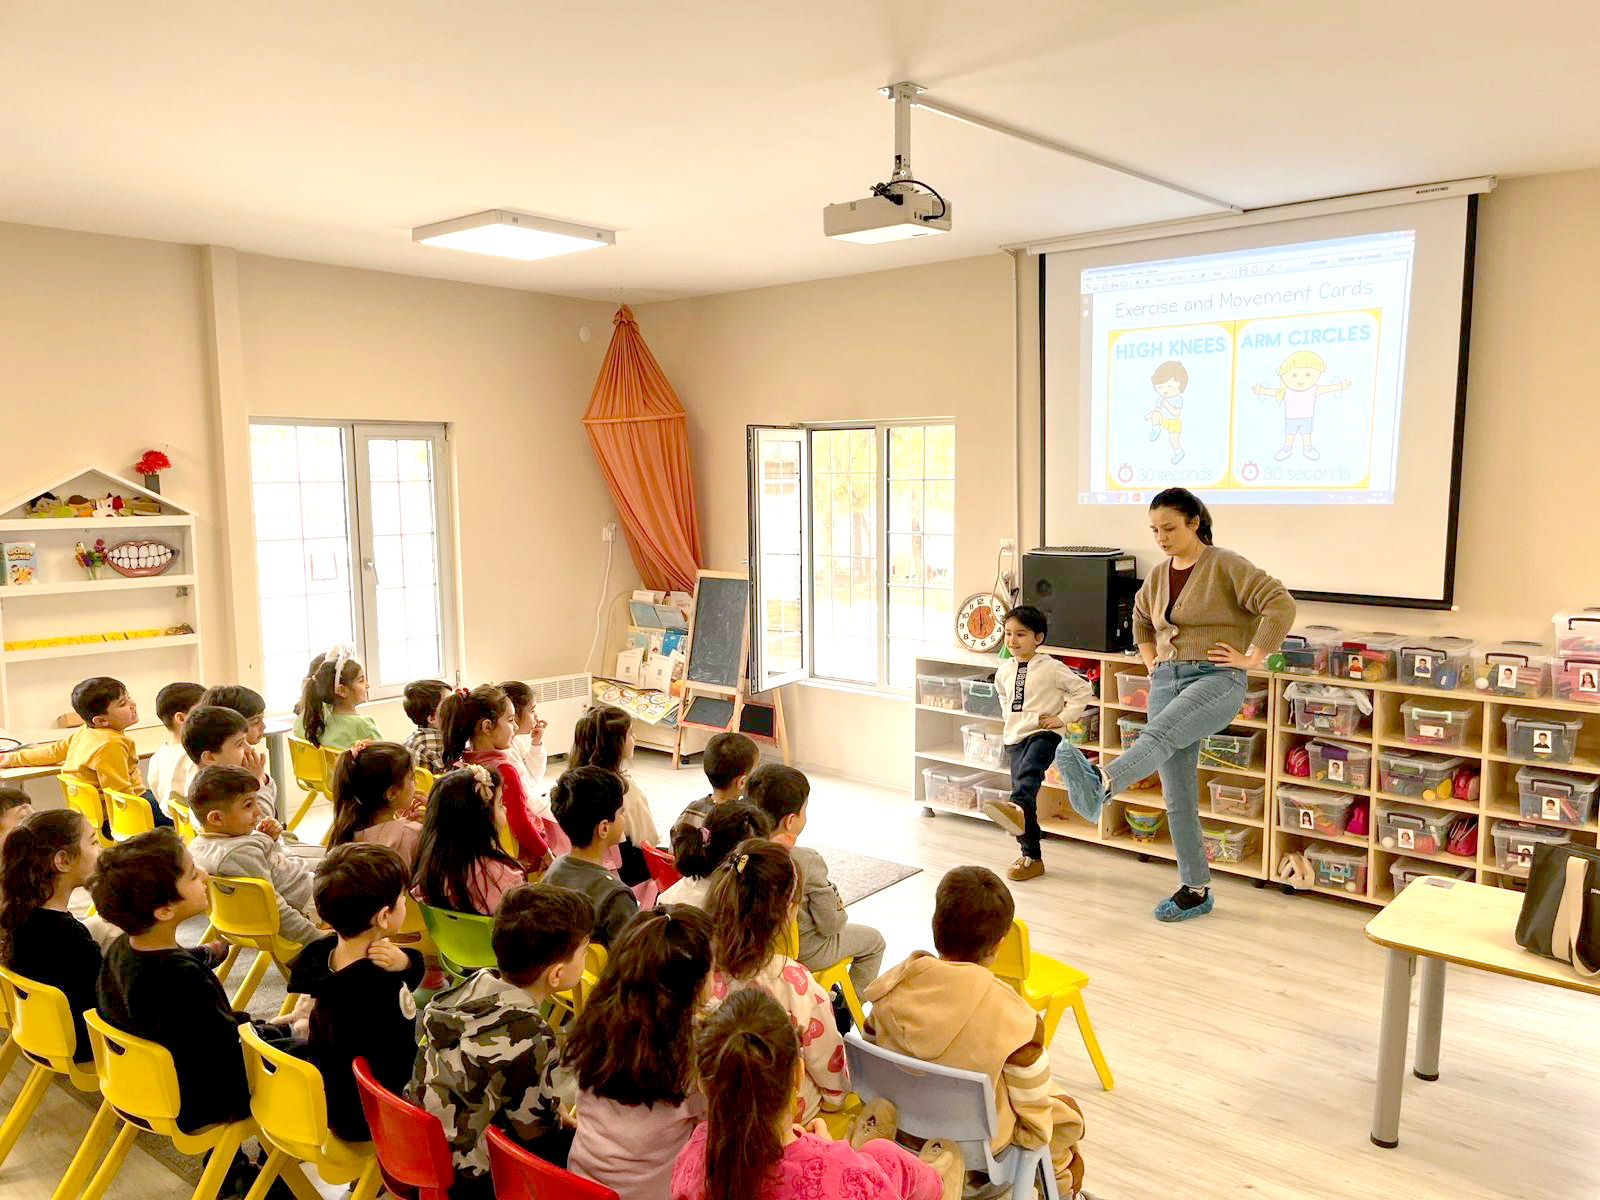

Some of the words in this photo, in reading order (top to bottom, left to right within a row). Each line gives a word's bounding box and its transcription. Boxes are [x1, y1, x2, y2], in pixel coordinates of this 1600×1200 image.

[1115, 297, 1178, 318] Exercise
[1184, 294, 1213, 312] and
[1220, 285, 1313, 309] Movement
[1319, 279, 1374, 299] Cards
[1116, 340, 1163, 359] HIGH
[1169, 336, 1226, 355] KNEES
[1241, 332, 1282, 349] ARM
[1288, 324, 1371, 345] CIRCLES
[1137, 468, 1154, 482] 30
[1158, 466, 1213, 481] seconds
[1264, 467, 1283, 481] 30
[1287, 466, 1351, 481] seconds
